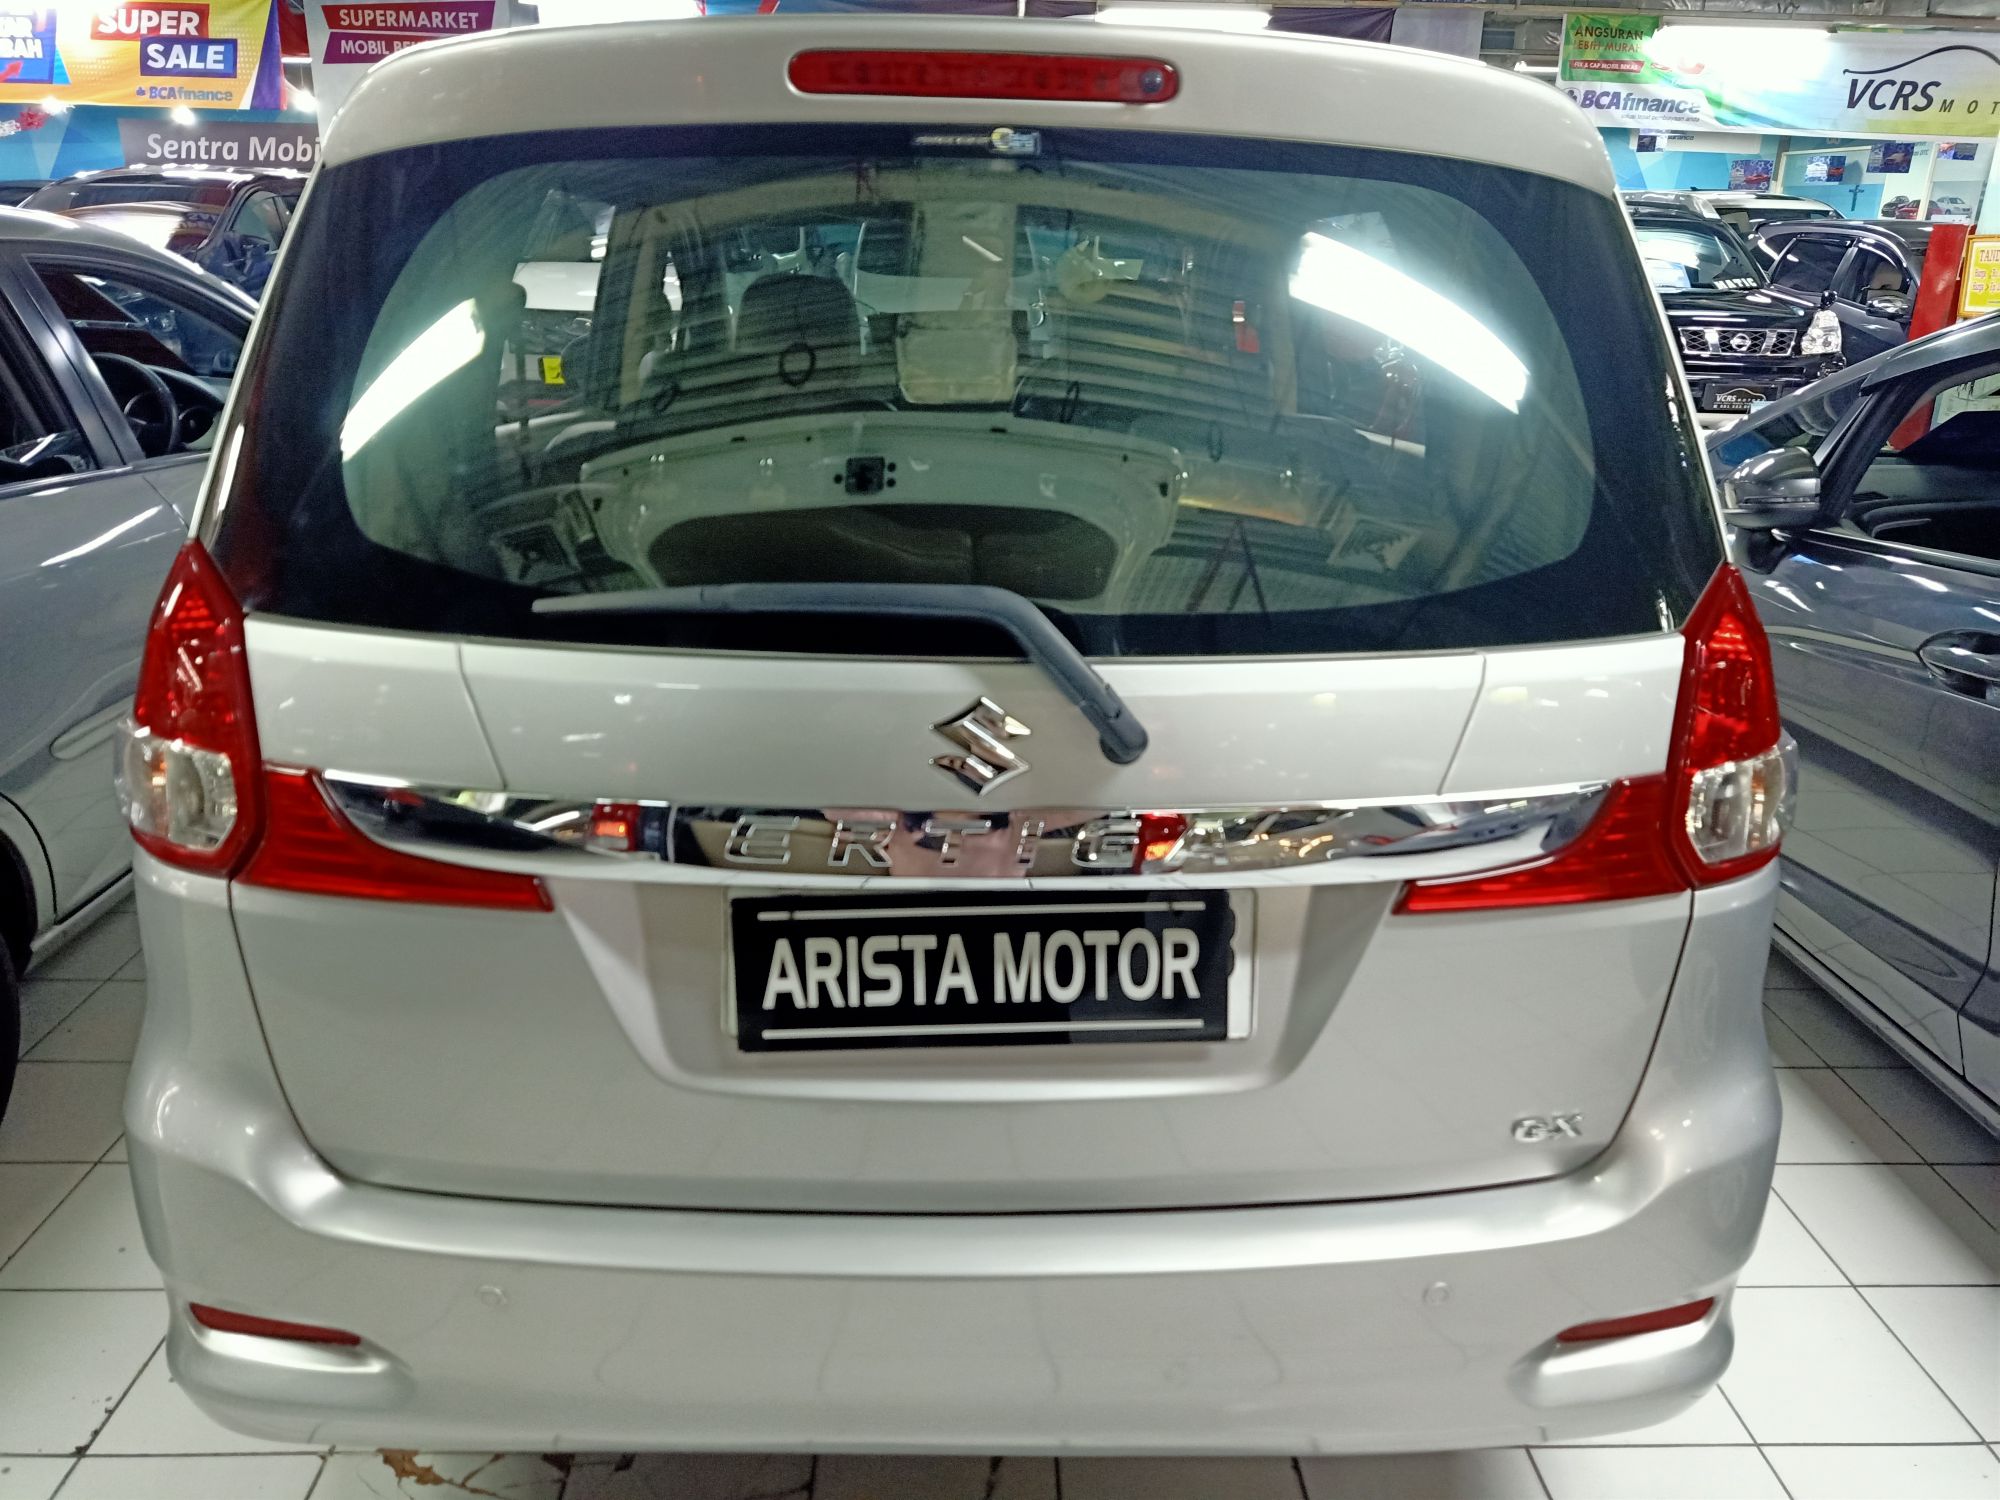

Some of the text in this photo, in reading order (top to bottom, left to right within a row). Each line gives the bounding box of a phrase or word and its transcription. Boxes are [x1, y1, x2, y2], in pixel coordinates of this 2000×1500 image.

[97, 8, 201, 36] SUPER
[339, 9, 479, 29] SUPERMARKET
[1574, 26, 1644, 40] ANGSURAN
[146, 43, 225, 70] SALE
[340, 40, 390, 55] MOBIL
[1847, 78, 1942, 112] VCRS
[147, 134, 238, 159] Sentra
[1713, 277, 1758, 290] MATIC
[725, 812, 1230, 872] ERTIGA
[761, 927, 1201, 1009] ARISTA MOTOR
[1510, 1115, 1584, 1143] GX
